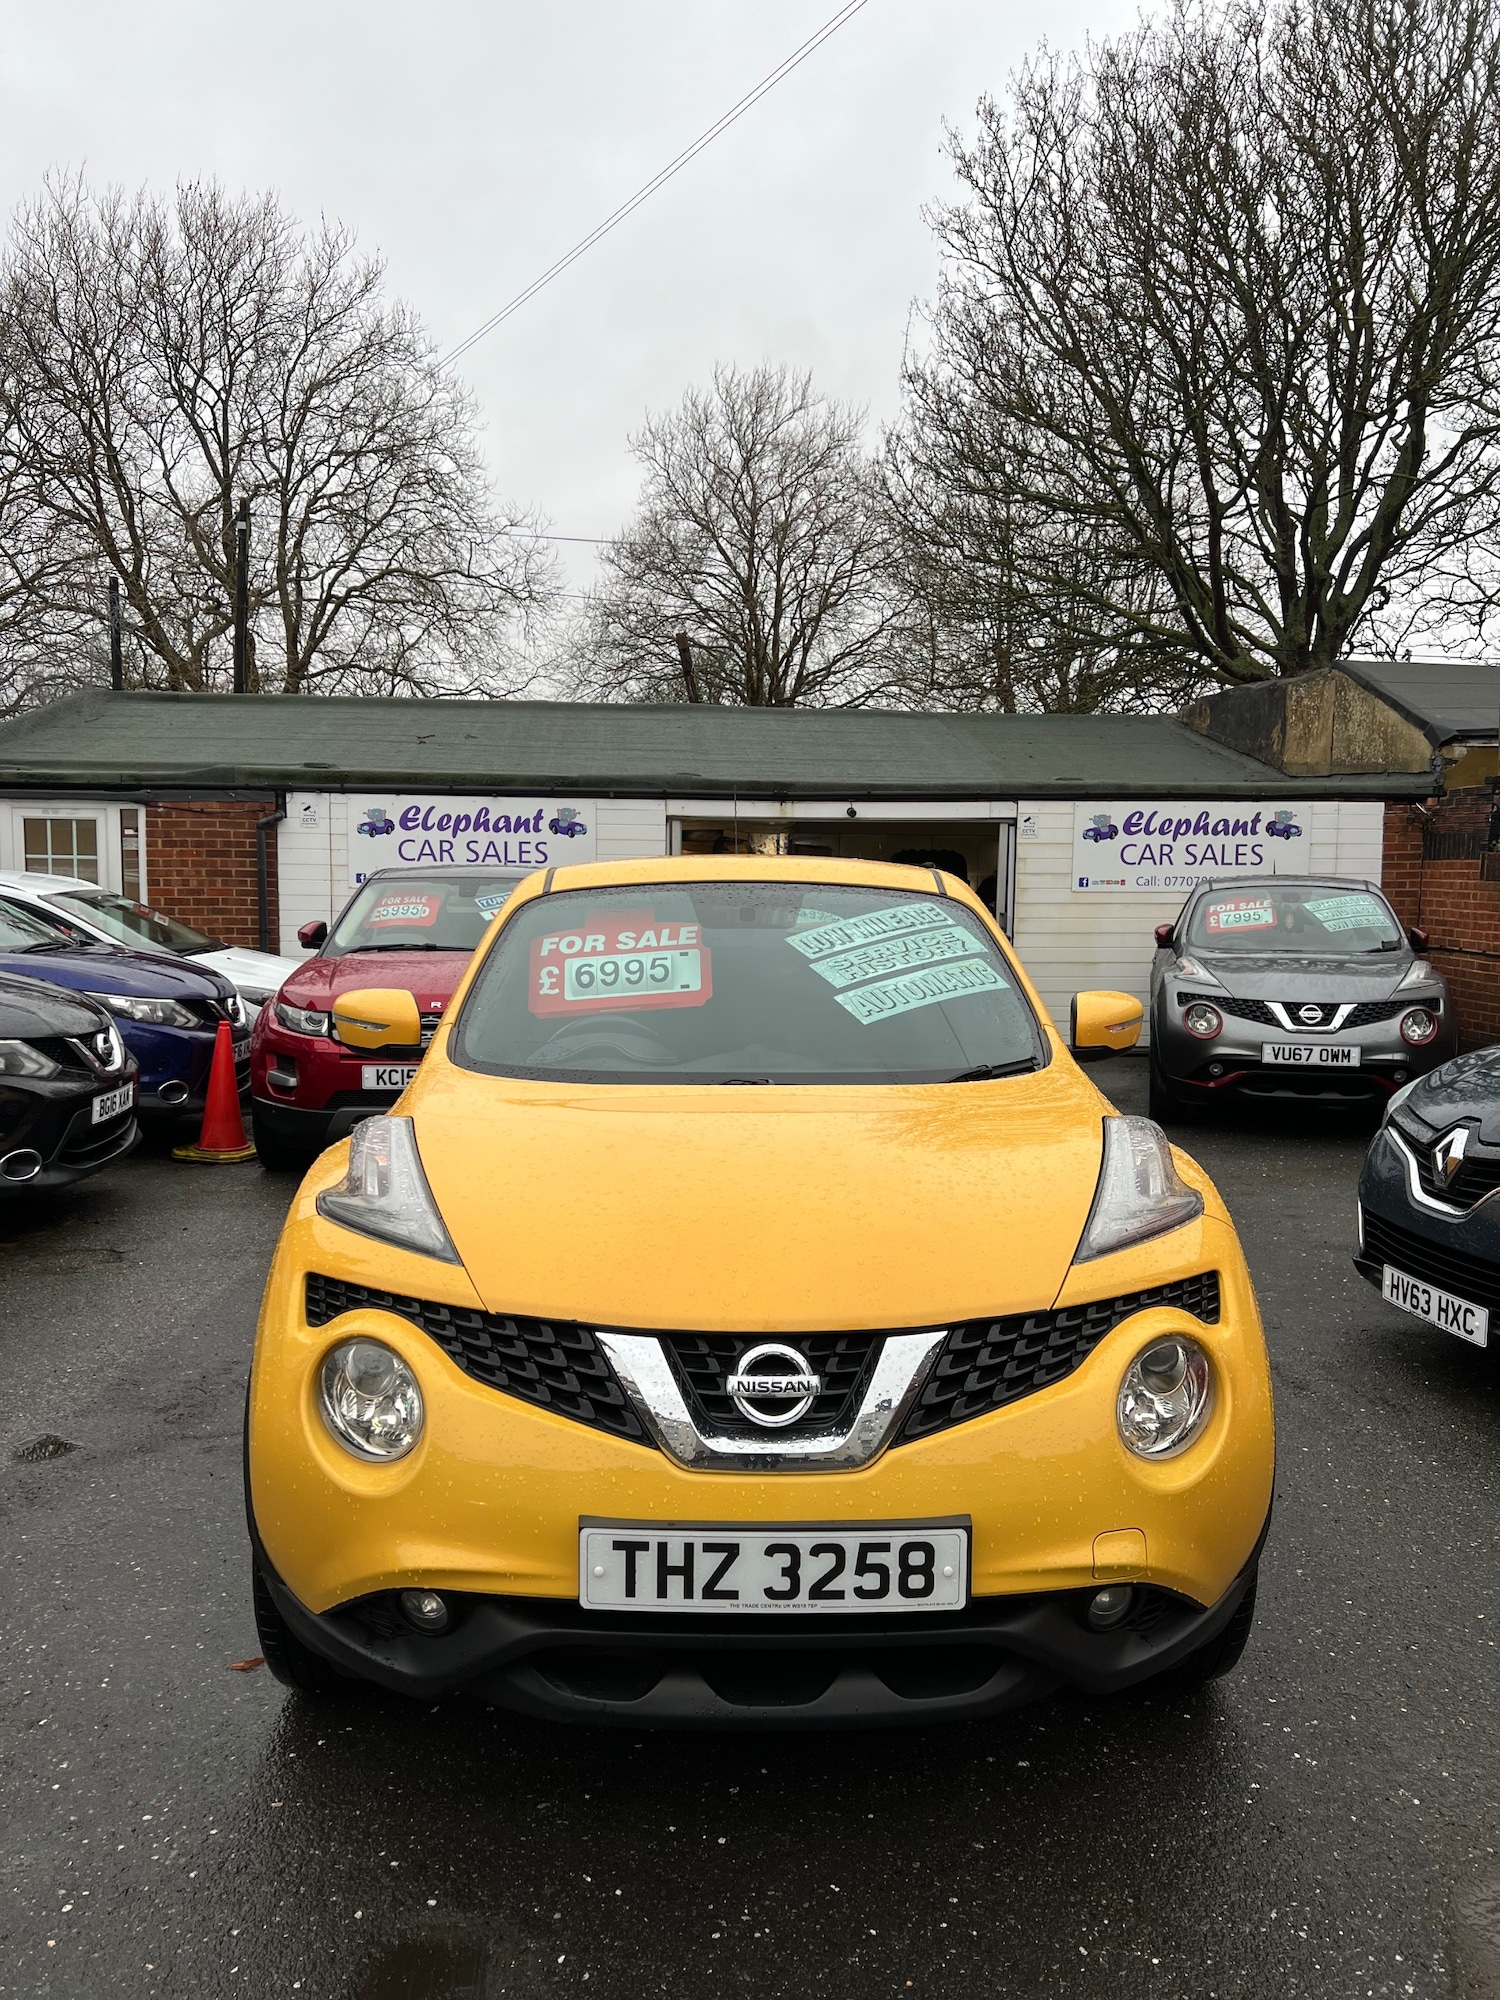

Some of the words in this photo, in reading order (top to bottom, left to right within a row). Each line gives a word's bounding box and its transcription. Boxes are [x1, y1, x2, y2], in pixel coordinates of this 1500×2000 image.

[399, 805, 544, 838] Elephant
[1122, 810, 1262, 842] Elephant
[398, 839, 455, 863] CAR
[466, 841, 549, 864] SALES
[1120, 843, 1174, 866] CAR
[1184, 844, 1264, 866] SALES
[1136, 875, 1160, 887] Call:
[381, 896, 402, 906] FOR
[403, 895, 429, 904] SALE
[480, 895, 508, 907] TUR
[1209, 904, 1235, 913] FOR
[1238, 900, 1271, 910] SALE
[797, 925, 855, 955] LOW
[848, 905, 948, 939] MILEAGE
[1223, 911, 1261, 924] 7995
[540, 934, 606, 956] FOR
[615, 926, 699, 950] SALE
[826, 930, 957, 969] SERVICE
[575, 957, 670, 989] 6995
[837, 940, 969, 981] HISTORY
[850, 963, 999, 1017] AUTOMATIC
[1272, 1046, 1313, 1062] VU67
[1320, 1048, 1351, 1063] OWM
[376, 1069, 417, 1086] KC15
[99, 1093, 117, 1118] BG16
[1390, 1272, 1431, 1315] HV63
[1437, 1295, 1476, 1336] HXC
[737, 1380, 811, 1393] NISSAN
[612, 1540, 740, 1600] THZ
[763, 1541, 935, 1600] 3258
